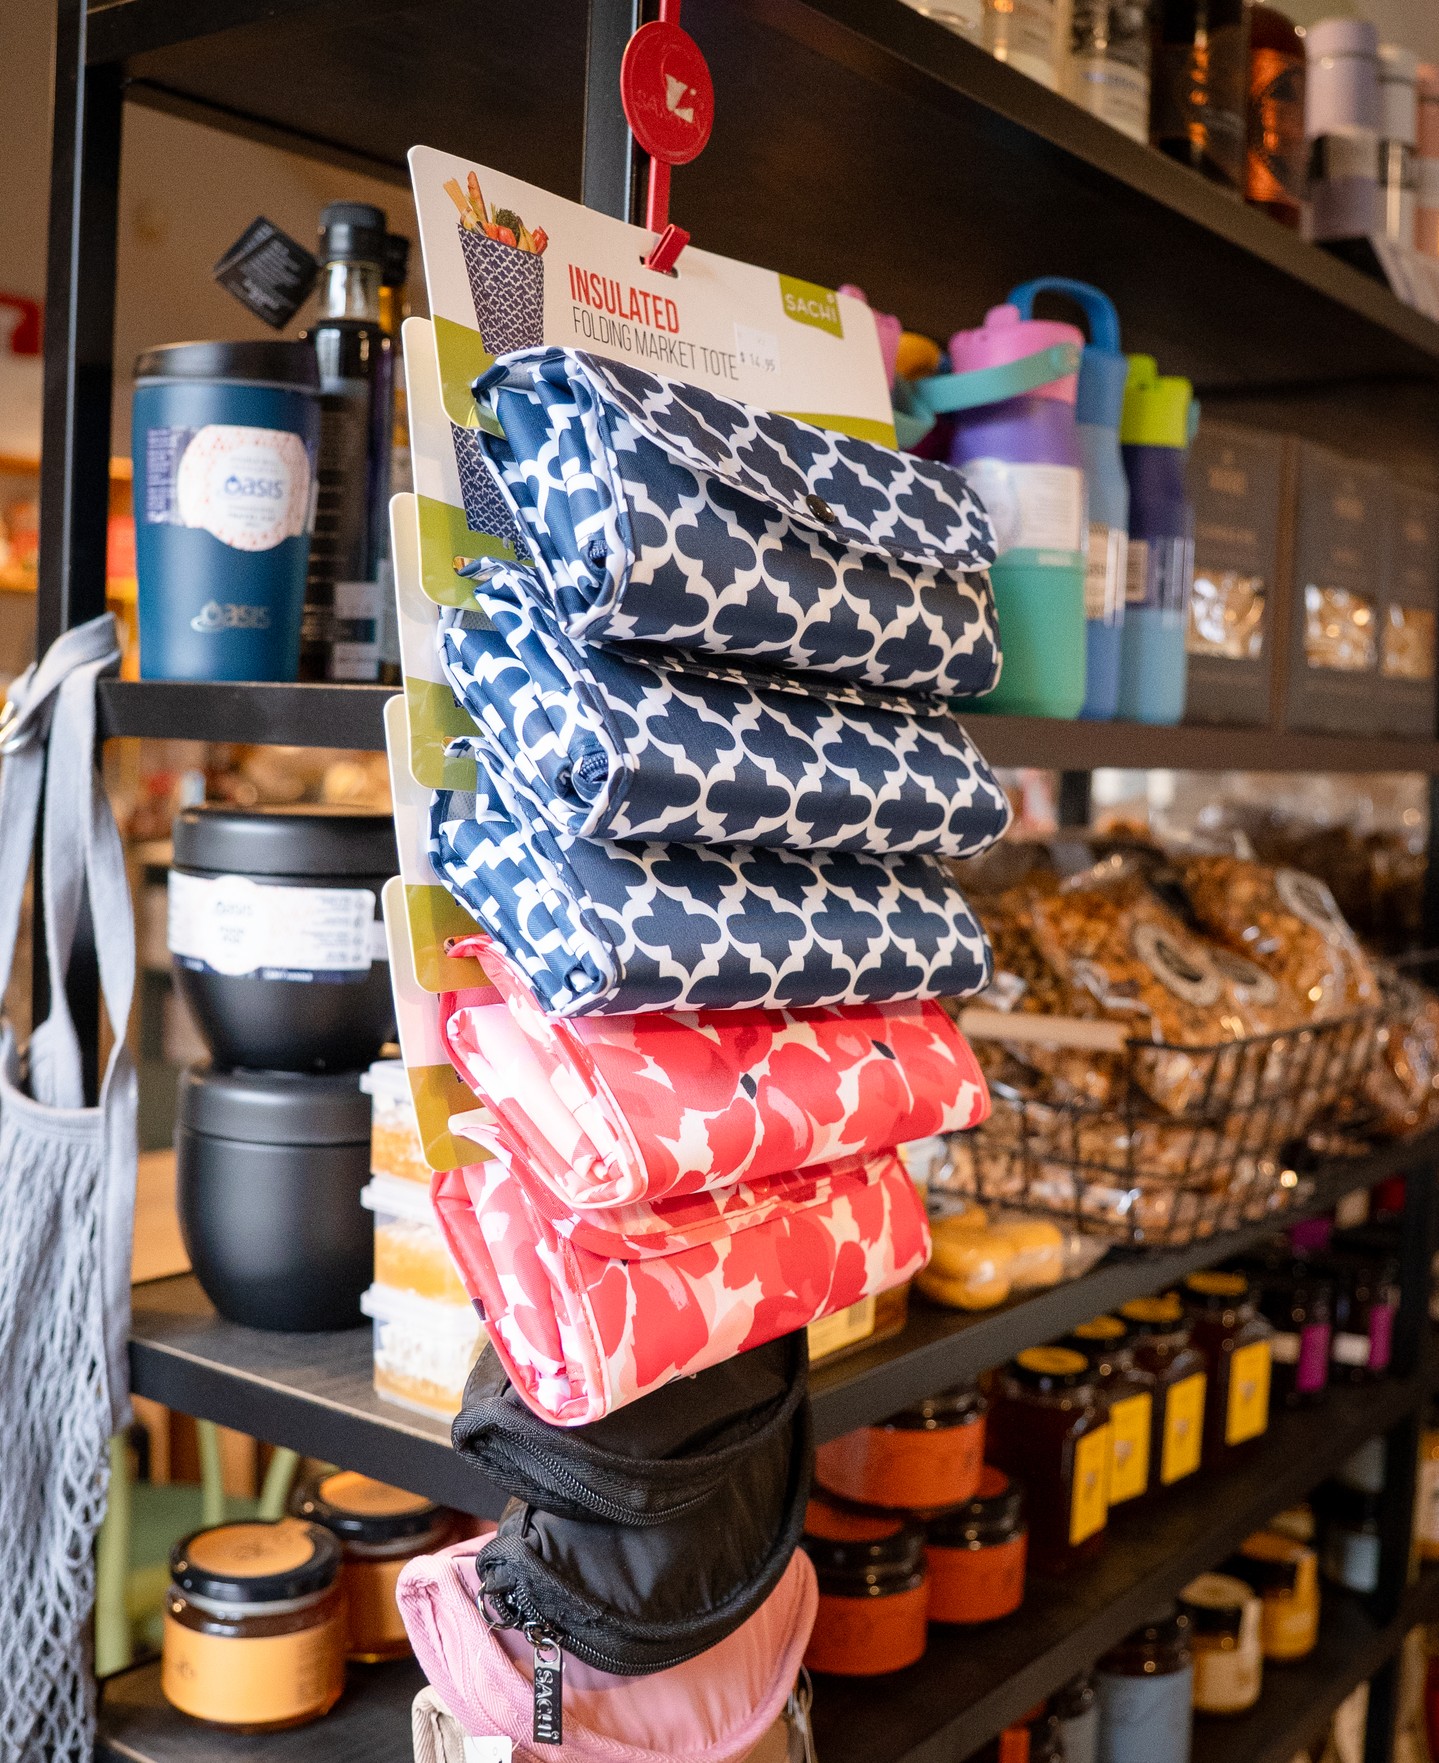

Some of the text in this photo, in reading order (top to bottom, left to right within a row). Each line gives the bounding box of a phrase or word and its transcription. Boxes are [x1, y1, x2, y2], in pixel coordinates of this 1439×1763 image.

[568, 264, 680, 334] INSULATED
[573, 306, 739, 380] FOLDING MARKET TOTE
[223, 474, 285, 500] Oasis
